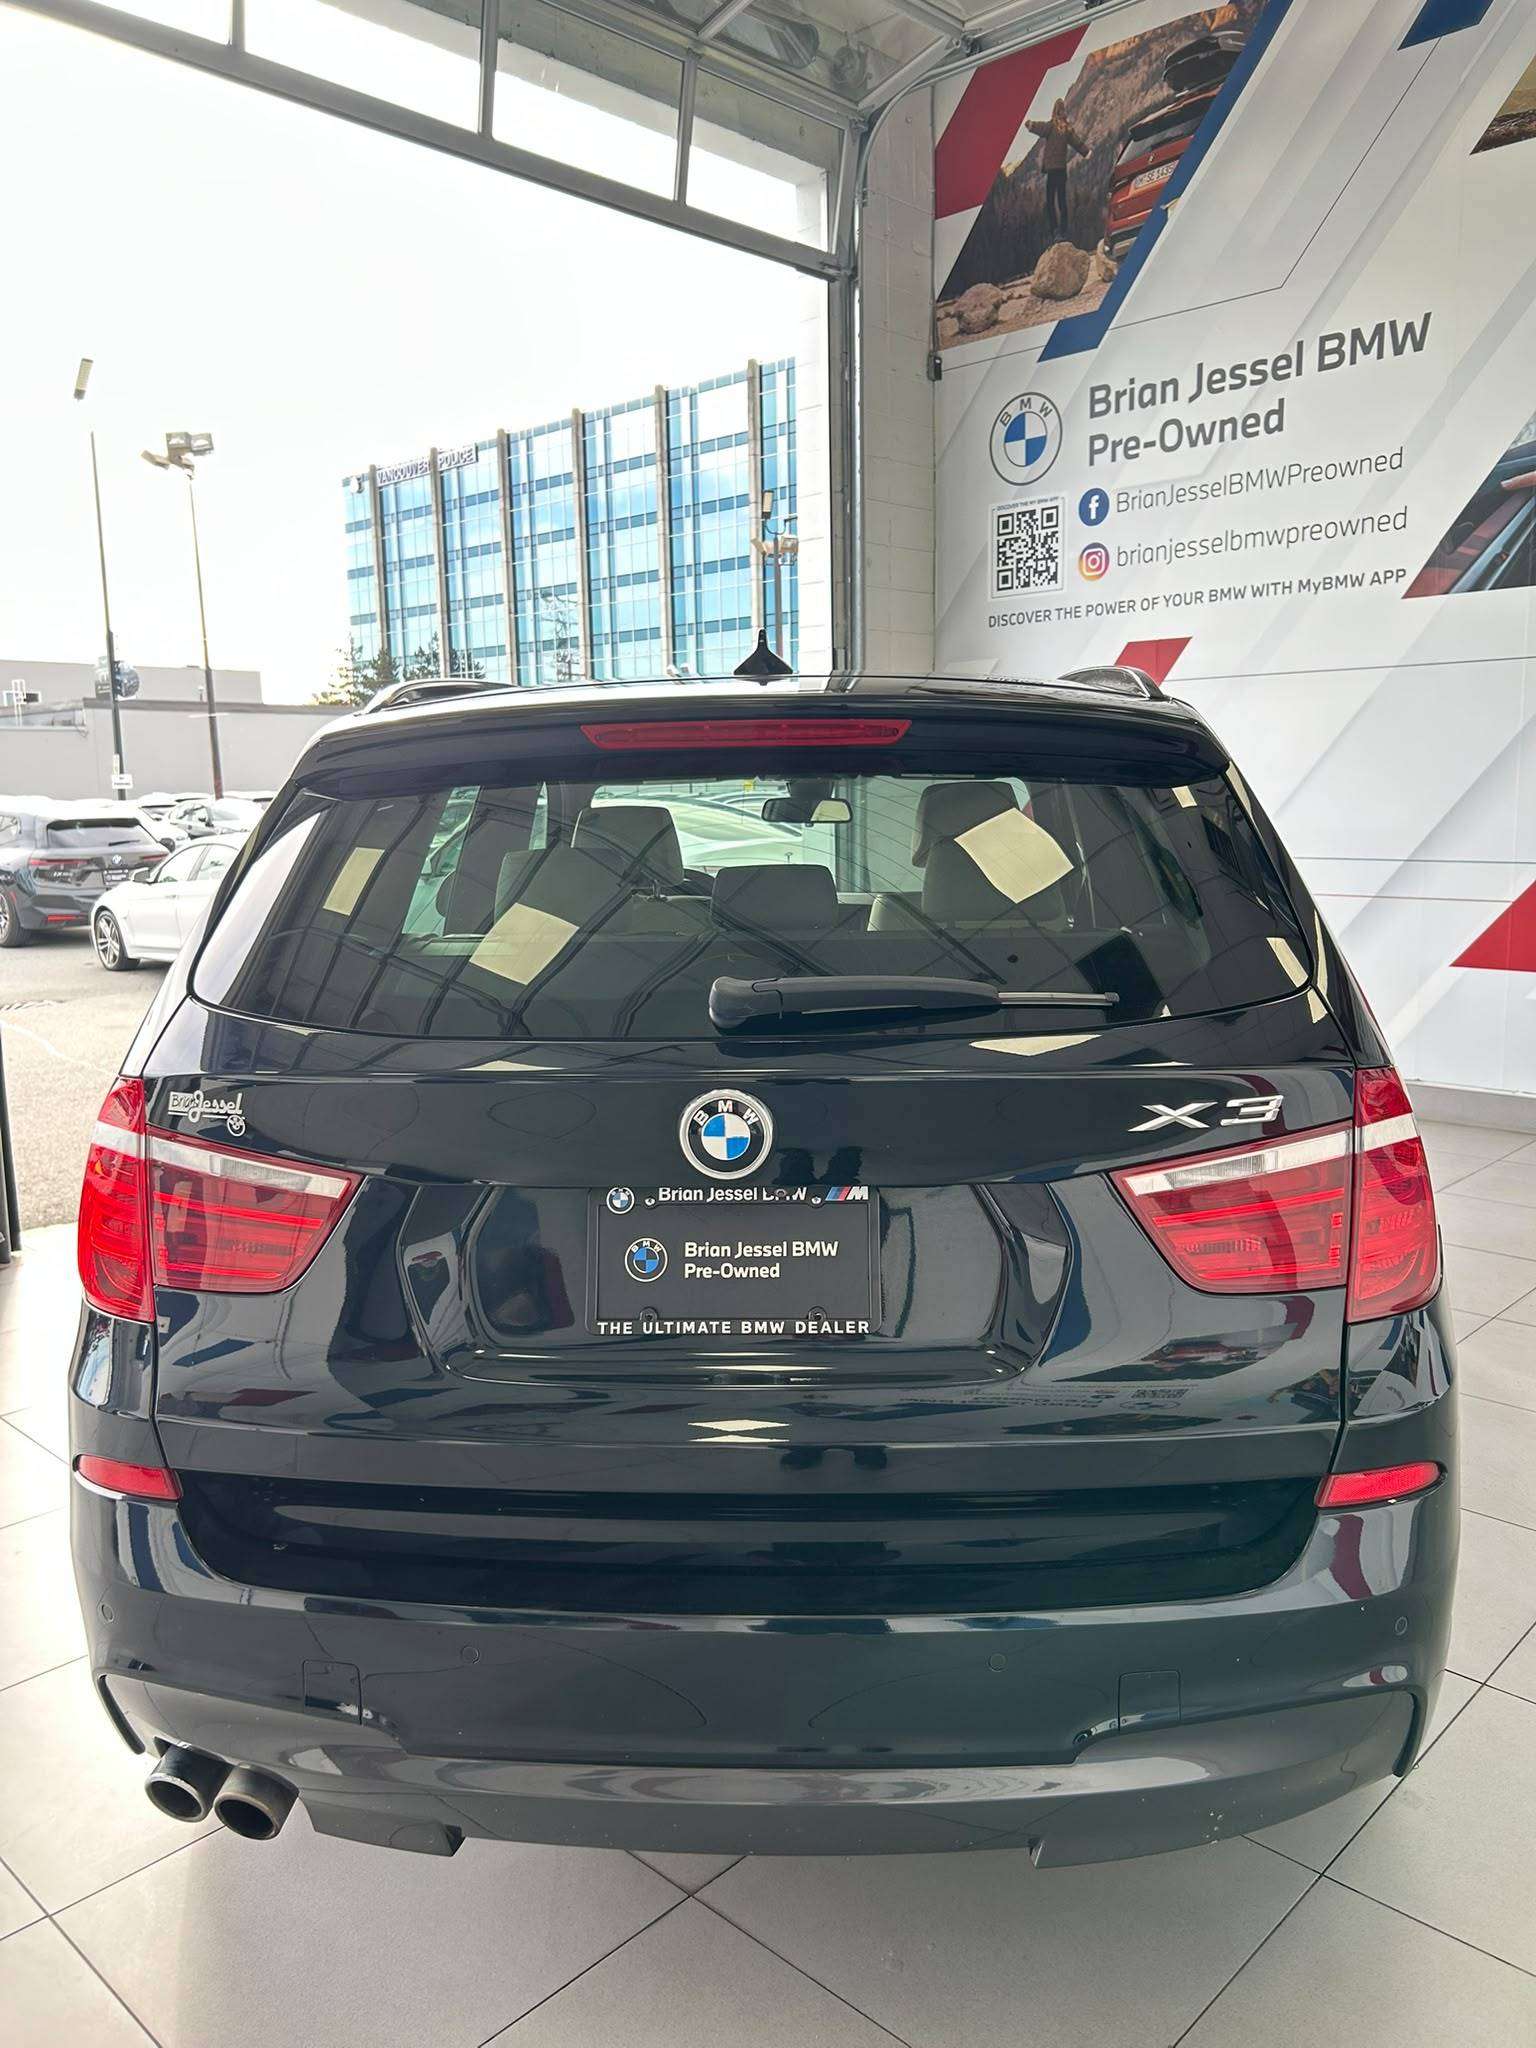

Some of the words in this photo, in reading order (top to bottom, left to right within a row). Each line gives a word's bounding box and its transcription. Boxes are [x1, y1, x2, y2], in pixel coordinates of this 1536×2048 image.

[1089, 377, 1179, 419] Brian
[1188, 340, 1304, 403] Jessel
[1317, 312, 1432, 372] BMW
[1089, 397, 1285, 466] Pre-Owned
[438, 448, 474, 469] POLICE
[1116, 446, 1404, 513] BrianJesselBMWPreowned
[1116, 506, 1408, 567] brianjesselbmwpreowned
[988, 610, 1051, 628] DISCOVER
[1055, 606, 1081, 620] THE
[1085, 600, 1136, 617] POWER
[1140, 596, 1160, 611] OF
[1162, 591, 1204, 607] YOUR
[1209, 585, 1247, 603] BMW
[1251, 580, 1293, 598] WITH
[1299, 573, 1365, 595] MyBMW
[1370, 568, 1407, 586] APP
[188, 1090, 243, 1123] Jessel
[1127, 1094, 1284, 1132] X3
[658, 1187, 703, 1201] Brian
[706, 1187, 758, 1203] Jessel
[684, 1241, 731, 1258] Brian
[734, 1241, 788, 1260] Jessel
[792, 1241, 839, 1257] BMW
[684, 1263, 780, 1278] Pre-Owned
[597, 1322, 633, 1335] THE
[642, 1320, 732, 1335] ULTIMATE
[741, 1320, 785, 1334] BMW
[795, 1320, 870, 1334] DEALER
